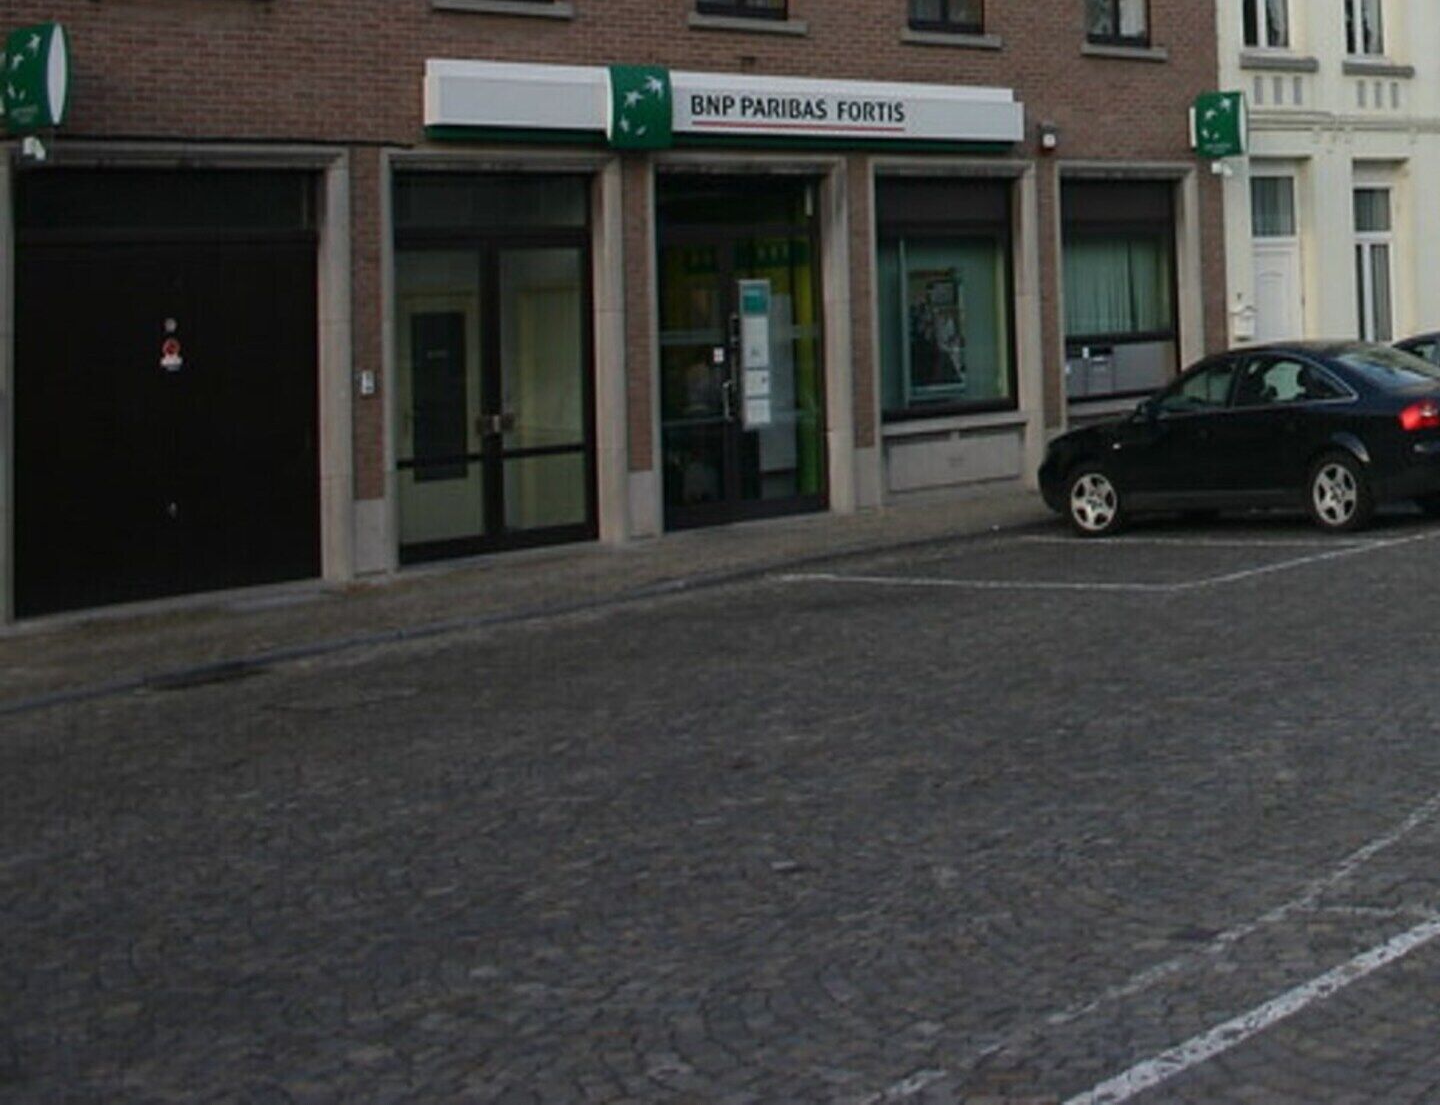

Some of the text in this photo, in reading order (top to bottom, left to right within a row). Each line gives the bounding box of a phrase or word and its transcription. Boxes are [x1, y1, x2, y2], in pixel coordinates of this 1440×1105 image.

[691, 94, 905, 123] BNP PARIBAS FORTIS
